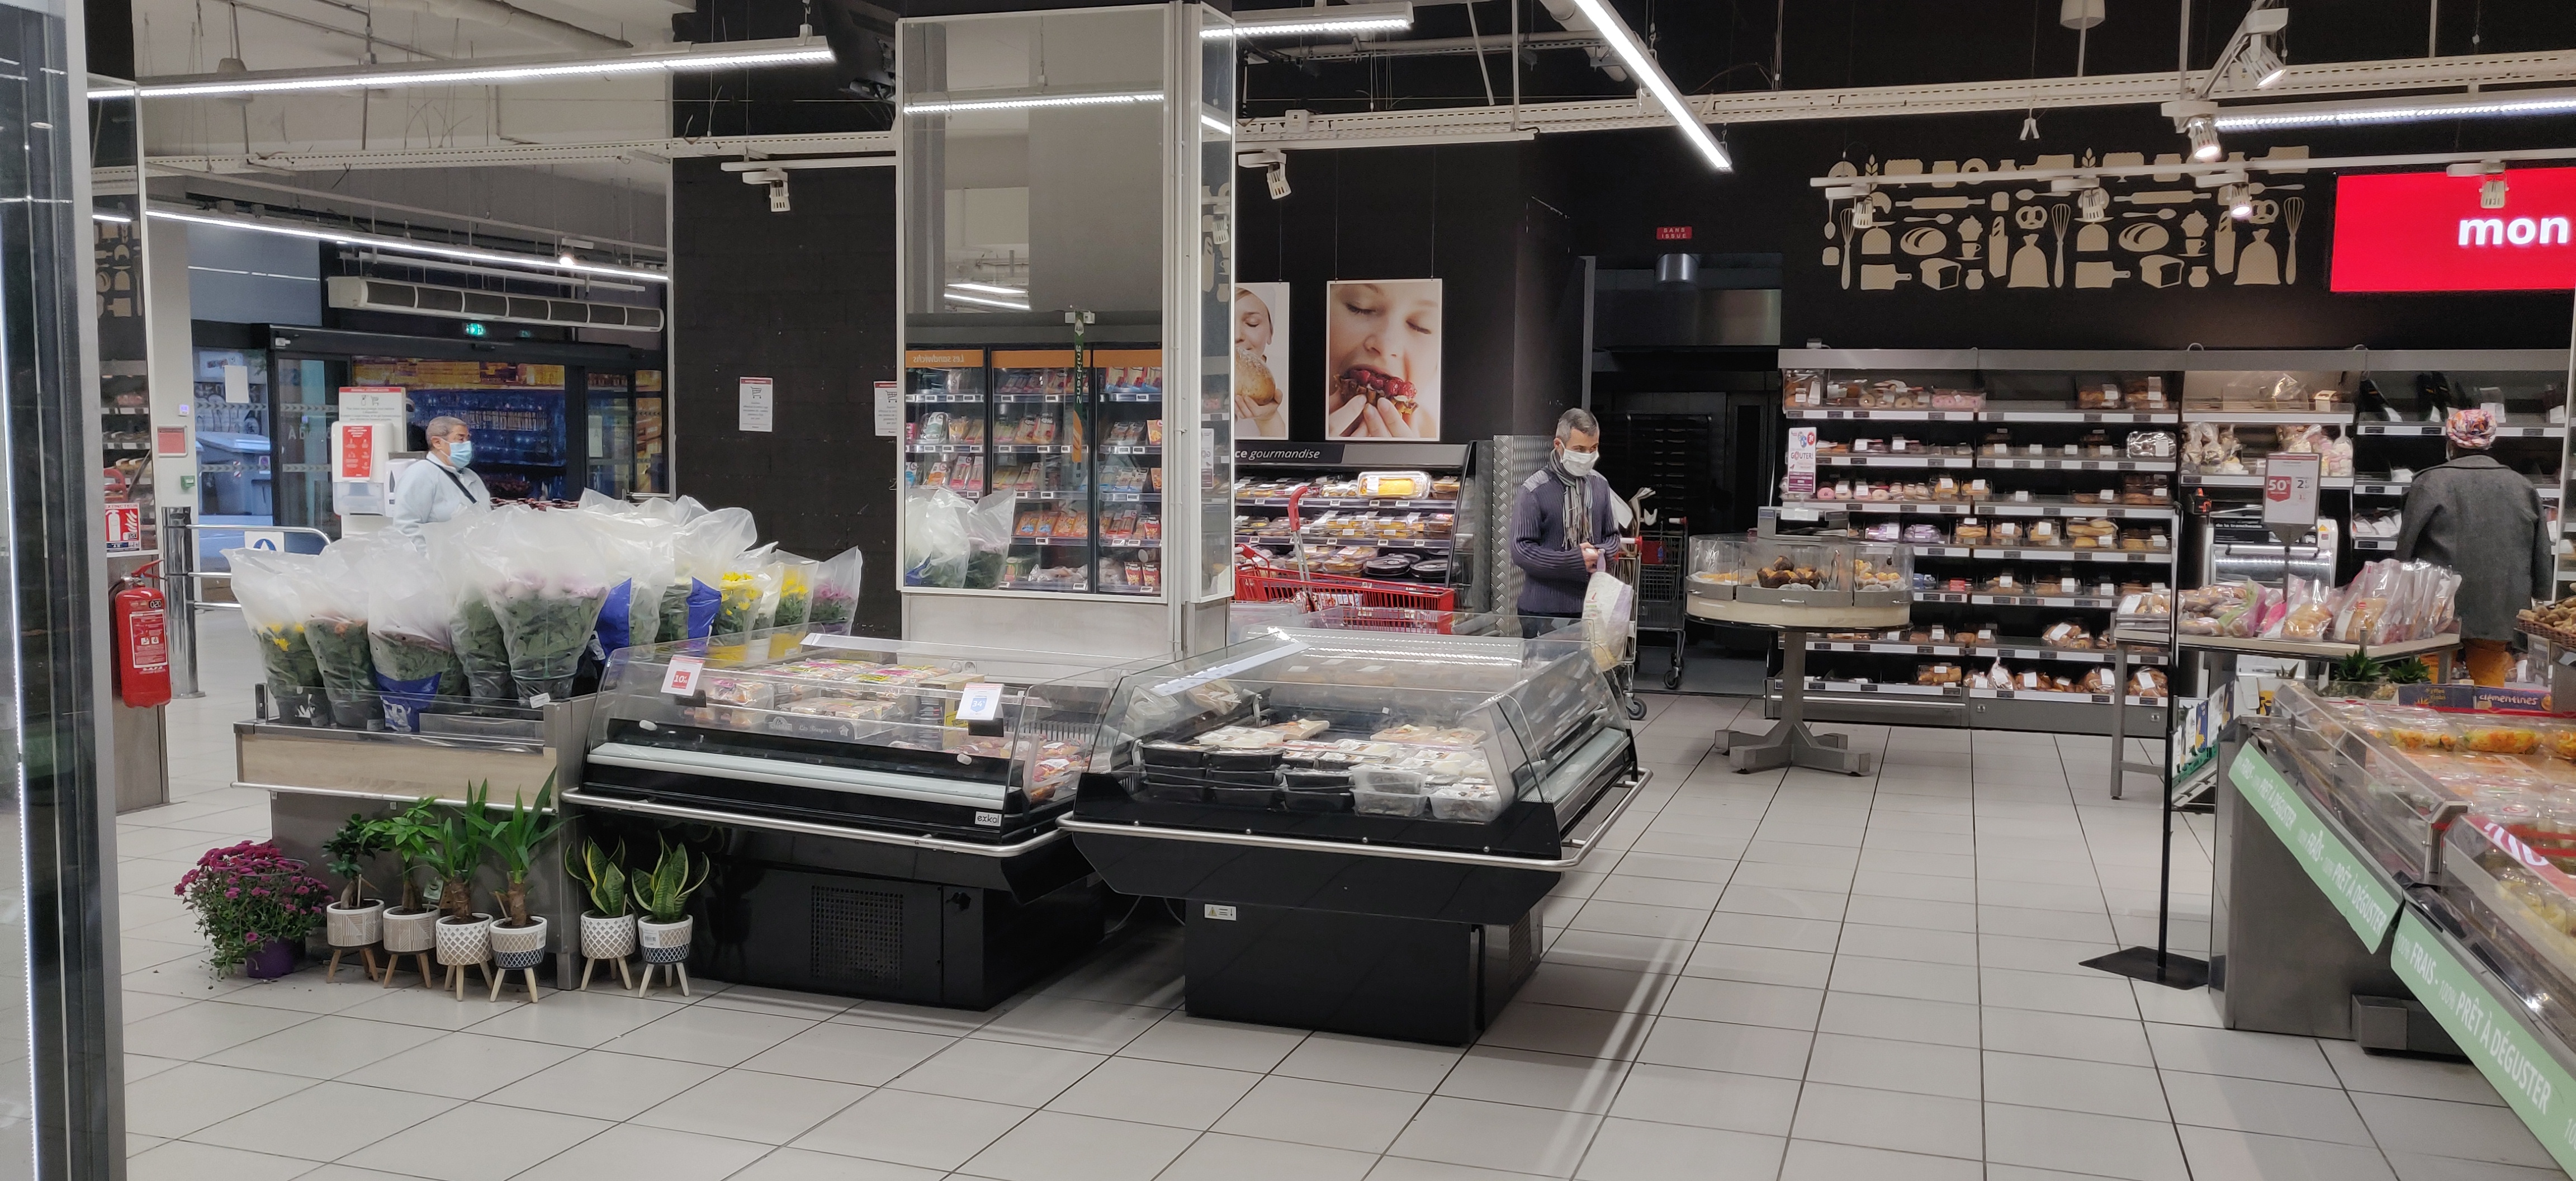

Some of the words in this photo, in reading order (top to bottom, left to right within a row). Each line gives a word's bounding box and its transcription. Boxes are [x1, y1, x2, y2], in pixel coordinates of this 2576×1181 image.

[2458, 217, 2568, 245] mon
[1248, 449, 1320, 460] gourmandise
[977, 814, 999, 823] exkal
[2332, 862, 2352, 894] PRÊT
[2352, 884, 2387, 937] DÉGUSTER
[2409, 942, 2437, 985] FRAIS
[2438, 979, 2457, 1010] 100%
[2455, 990, 2484, 1037] PRÊT
[2480, 1010, 2493, 1049] À
[2489, 1027, 2551, 1115] DÉGUSTER
